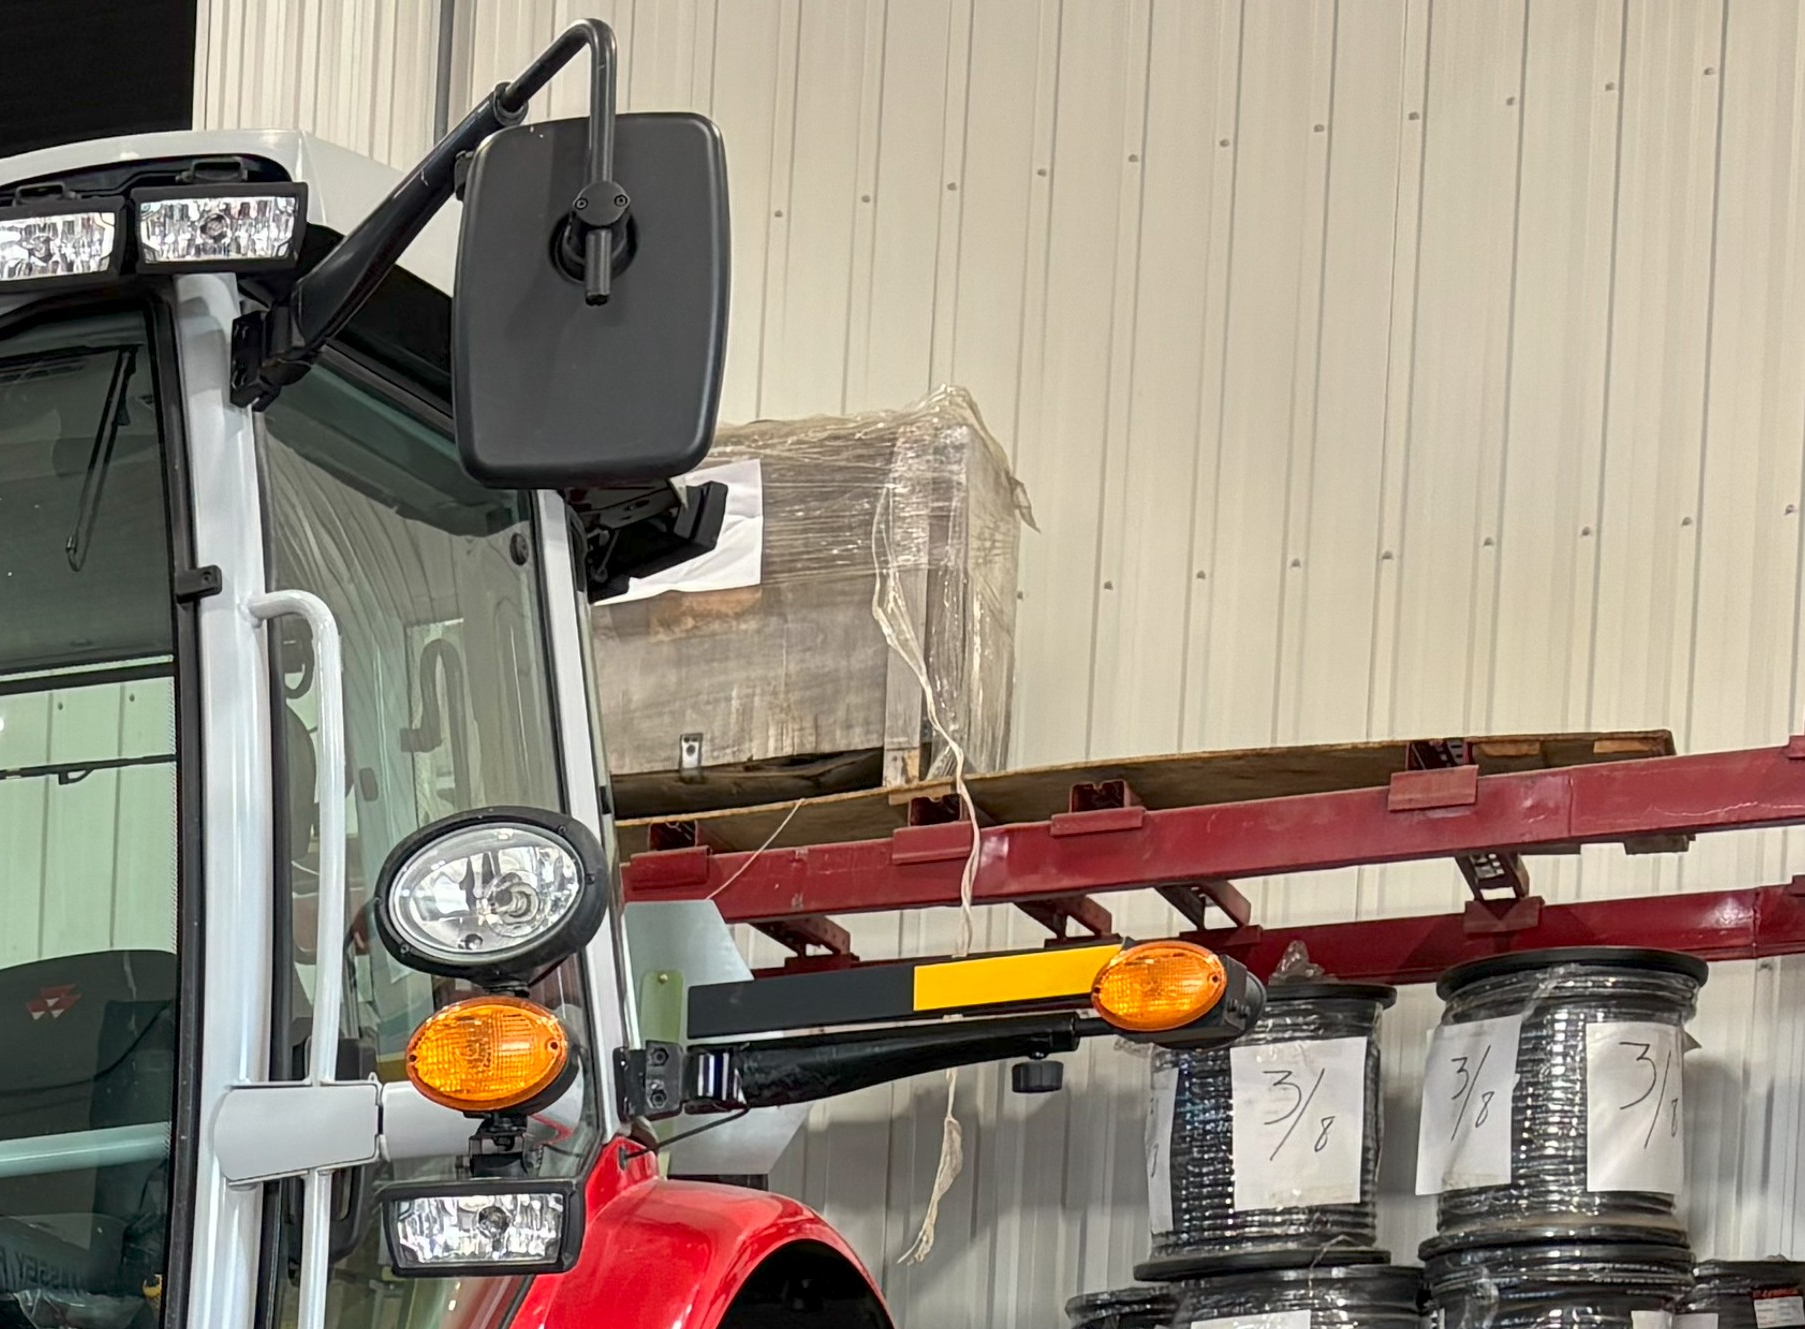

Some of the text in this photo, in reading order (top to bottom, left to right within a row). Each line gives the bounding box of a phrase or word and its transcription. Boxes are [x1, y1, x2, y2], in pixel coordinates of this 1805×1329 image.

[1263, 1067, 1335, 1161] 3/8
[1450, 1044, 1495, 1142] 3/8
[1618, 1041, 1679, 1149] 3/8
